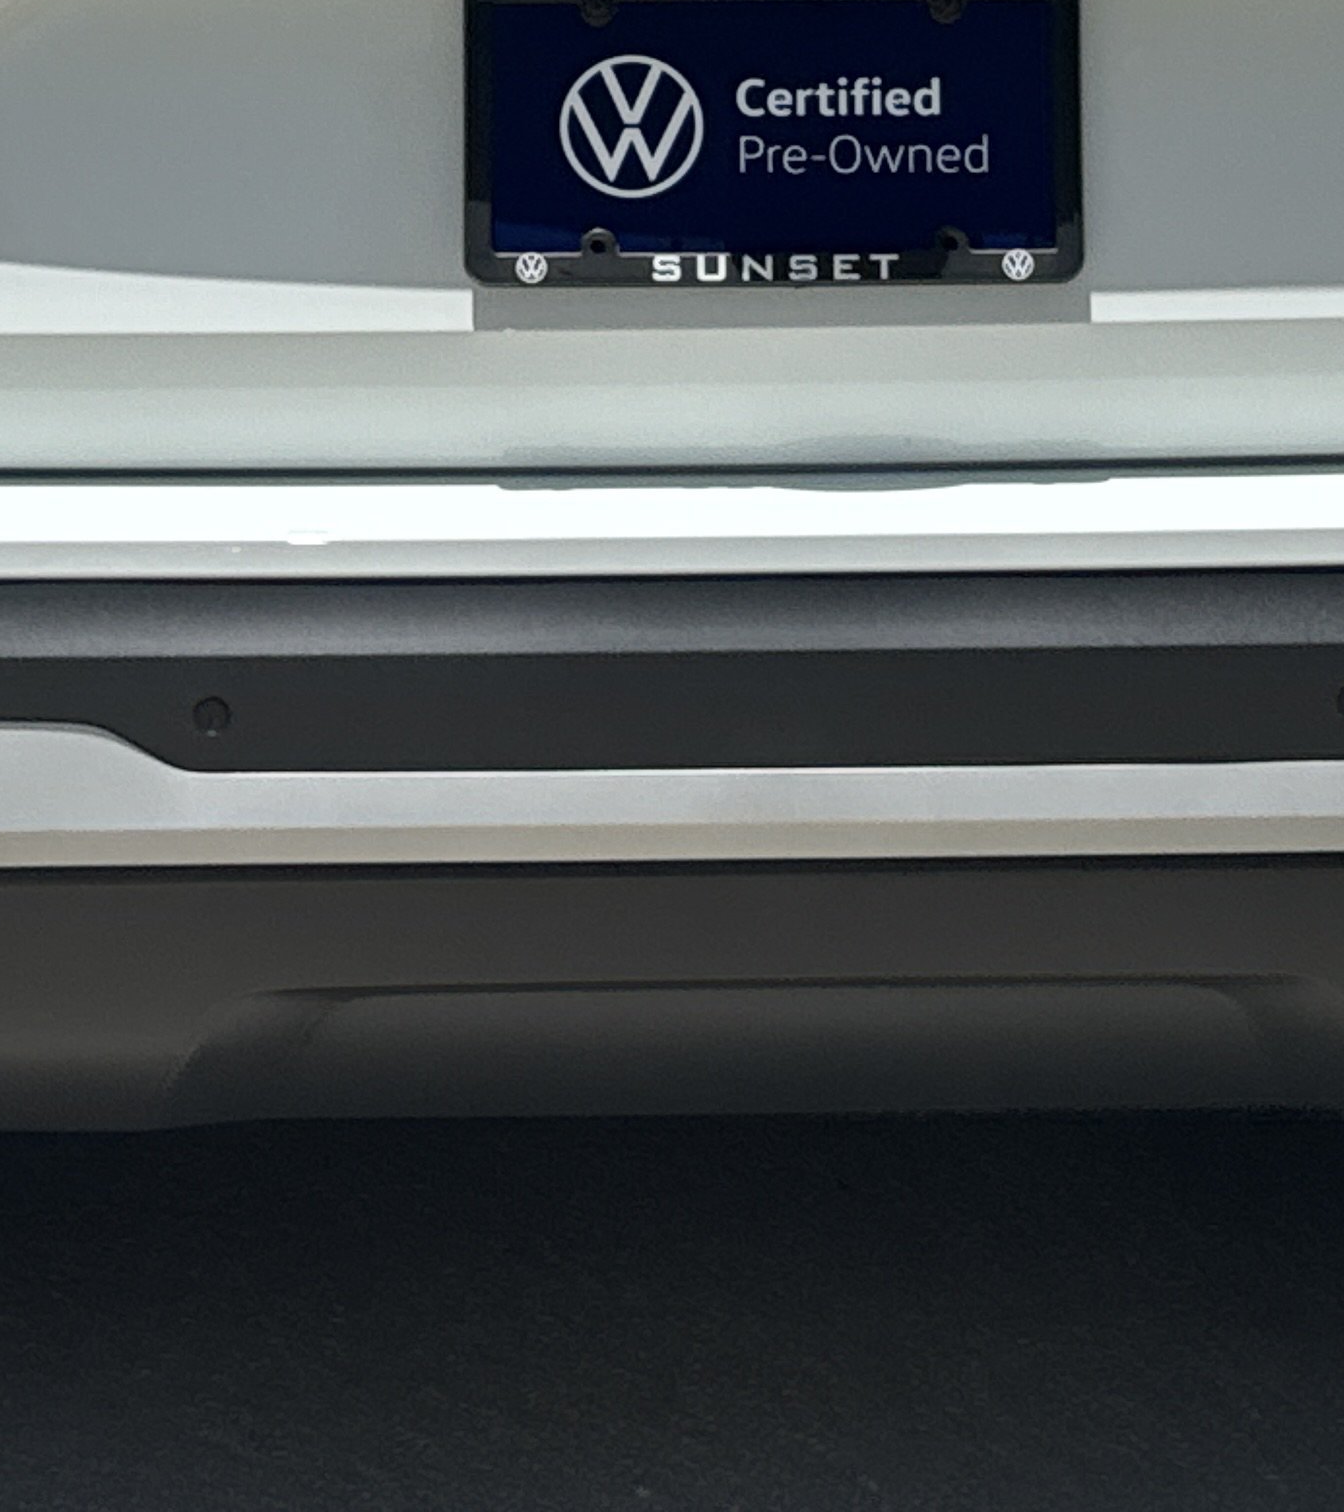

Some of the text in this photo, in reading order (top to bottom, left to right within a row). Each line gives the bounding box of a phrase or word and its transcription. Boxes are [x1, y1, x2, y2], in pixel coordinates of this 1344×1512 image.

[736, 76, 942, 117] Certified
[739, 133, 989, 174] Pre-Owned
[651, 253, 900, 282] SUNSET
